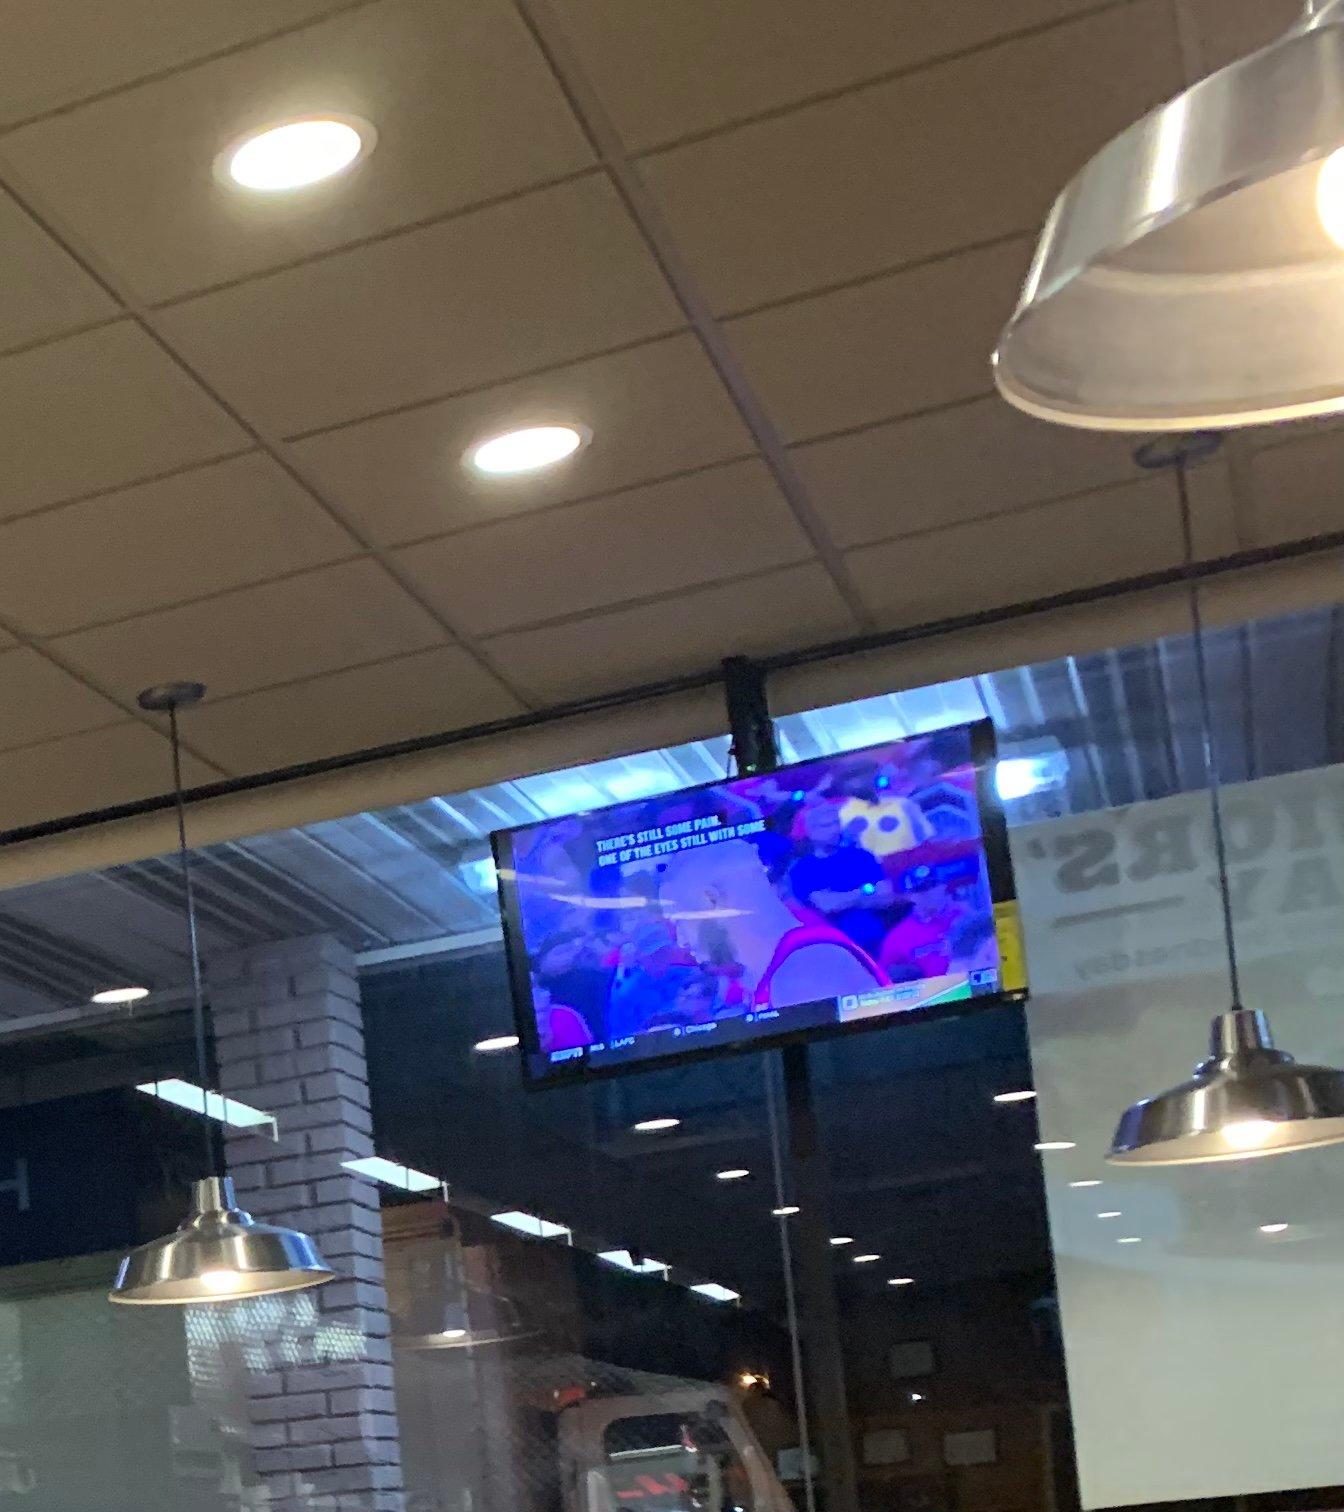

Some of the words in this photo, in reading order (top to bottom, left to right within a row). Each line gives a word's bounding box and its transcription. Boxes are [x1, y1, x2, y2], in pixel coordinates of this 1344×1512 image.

[597, 833, 636, 852] THERE'S
[637, 828, 663, 844] STILL
[665, 821, 693, 837] SOME
[598, 852, 618, 867] ONE
[620, 849, 633, 862] OF
[634, 845, 653, 859] THE
[655, 839, 678, 855] EYES
[680, 833, 708, 849] STILL
[708, 826, 736, 842] WITH
[737, 820, 766, 836] SOME
